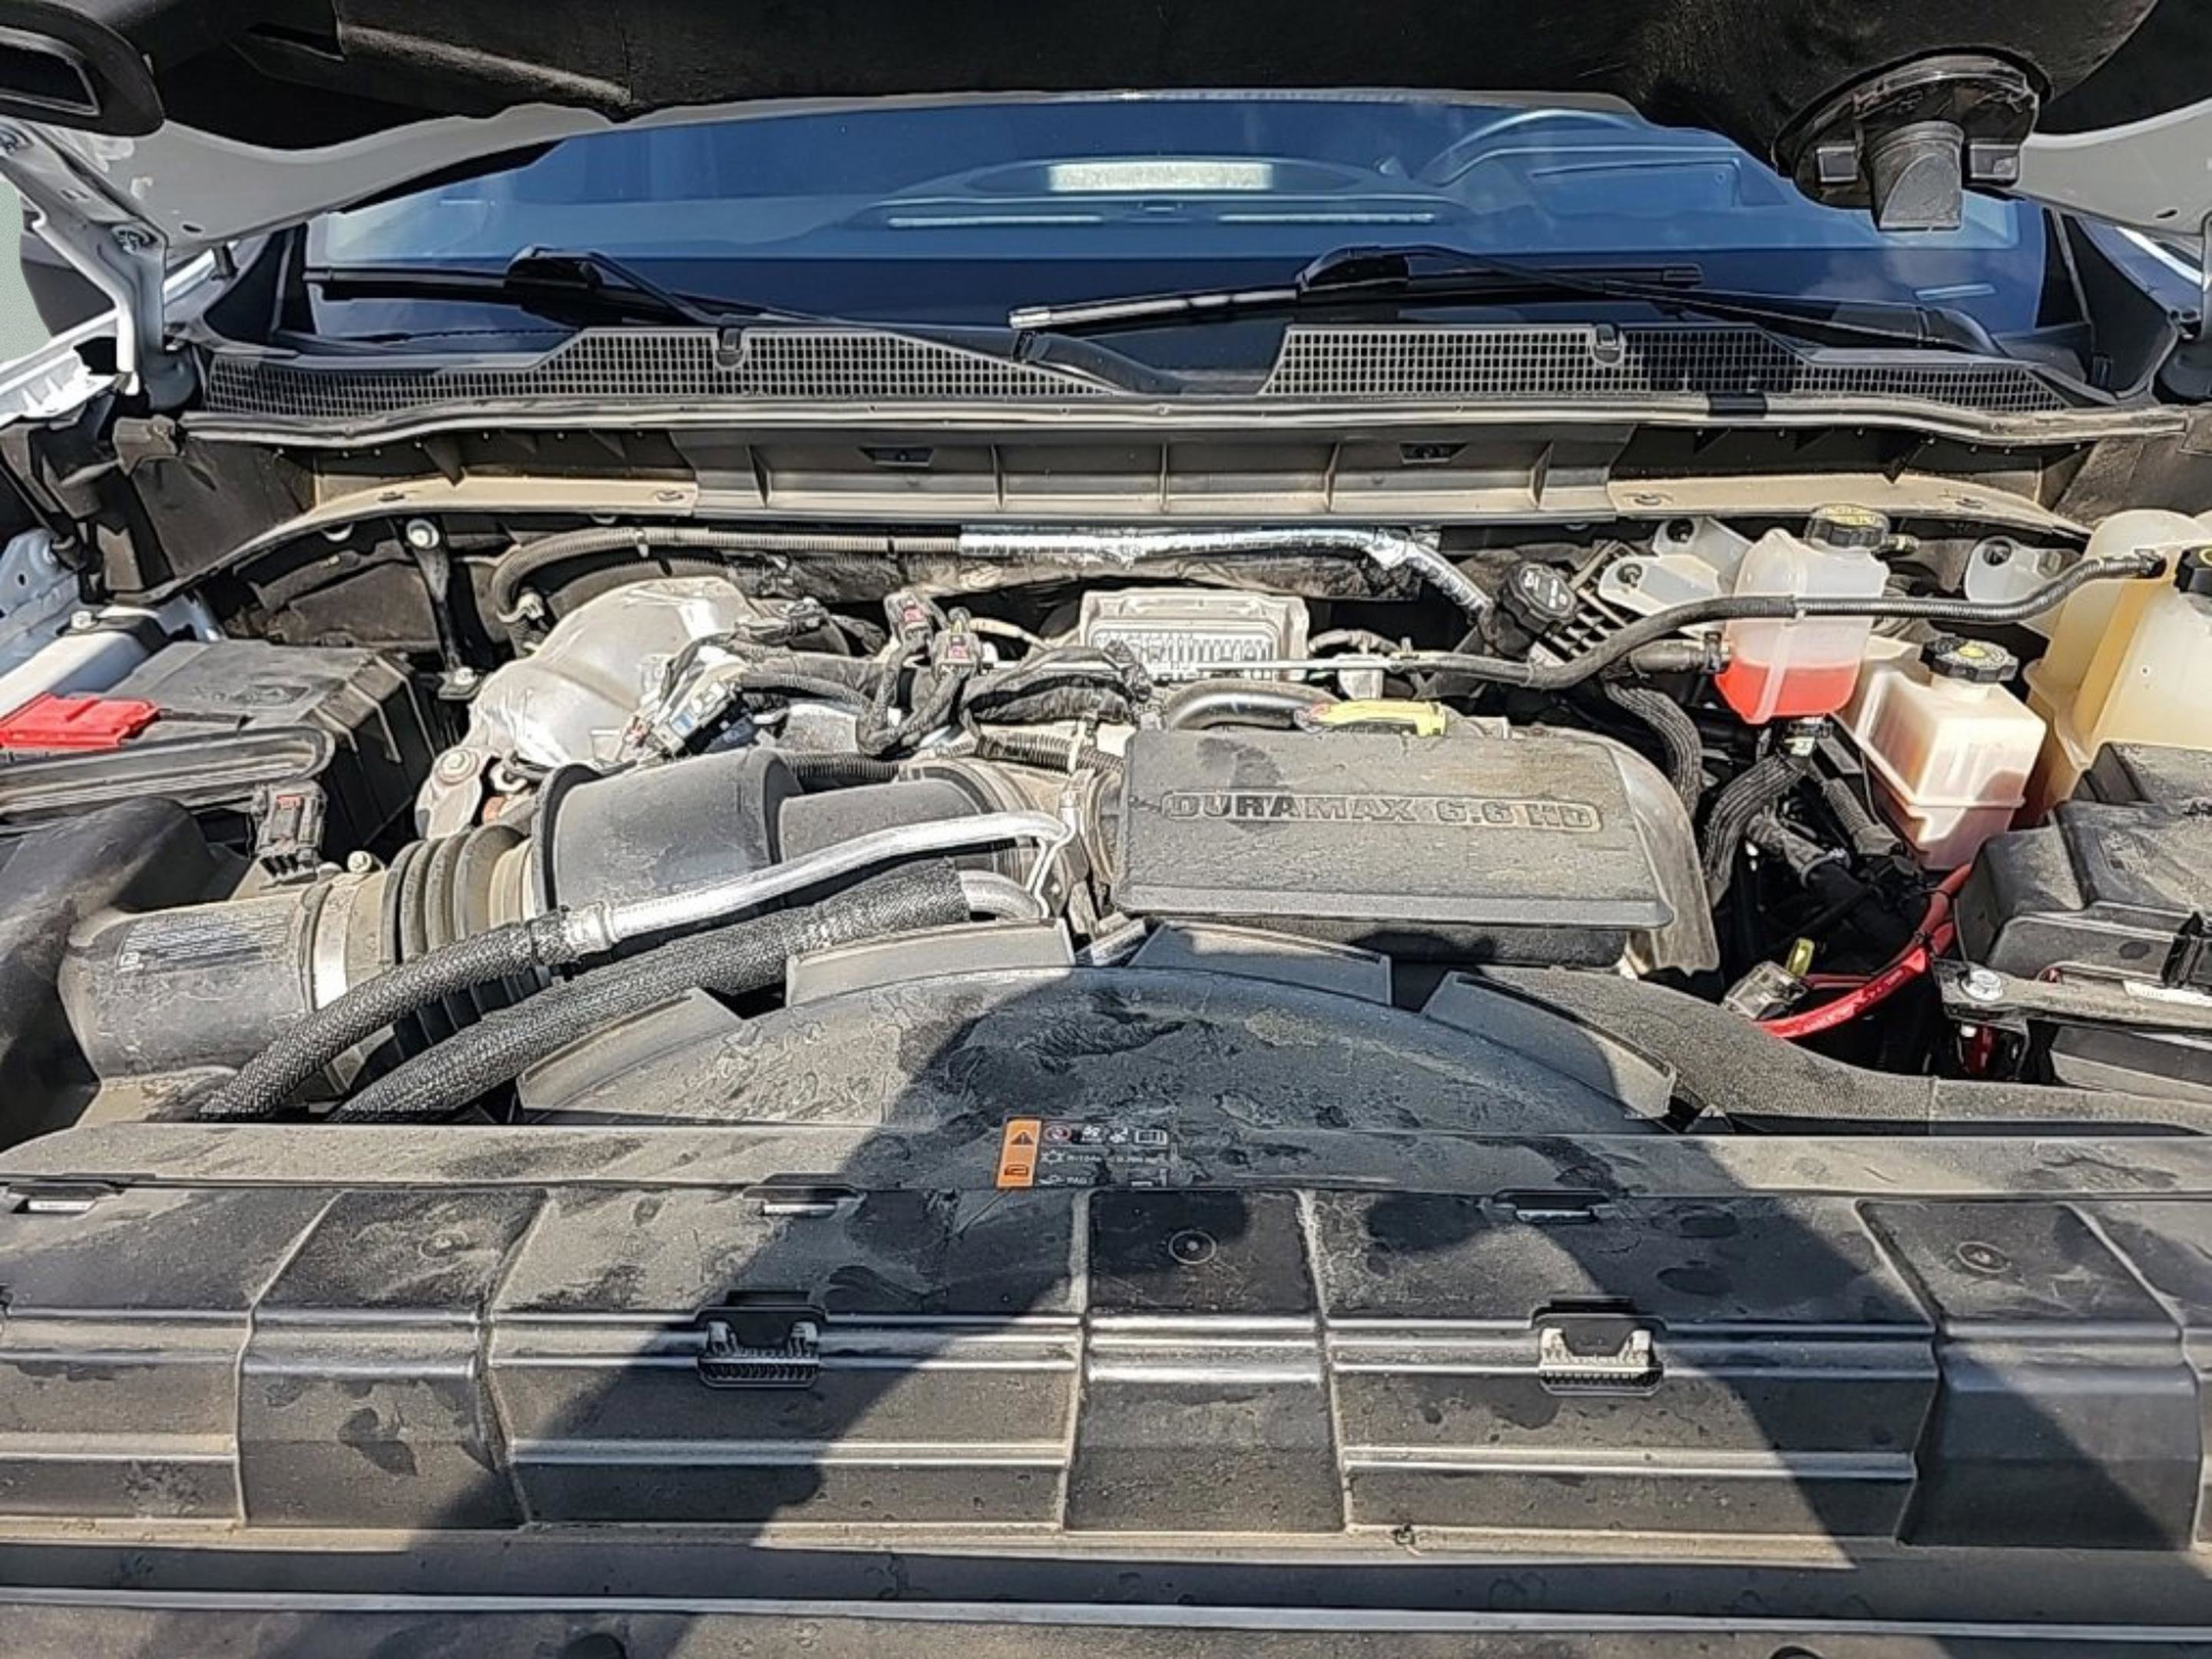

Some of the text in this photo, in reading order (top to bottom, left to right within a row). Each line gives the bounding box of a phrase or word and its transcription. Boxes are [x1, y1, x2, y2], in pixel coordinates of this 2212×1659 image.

[1168, 794, 1593, 828] DURAMAX 6.6 HD
